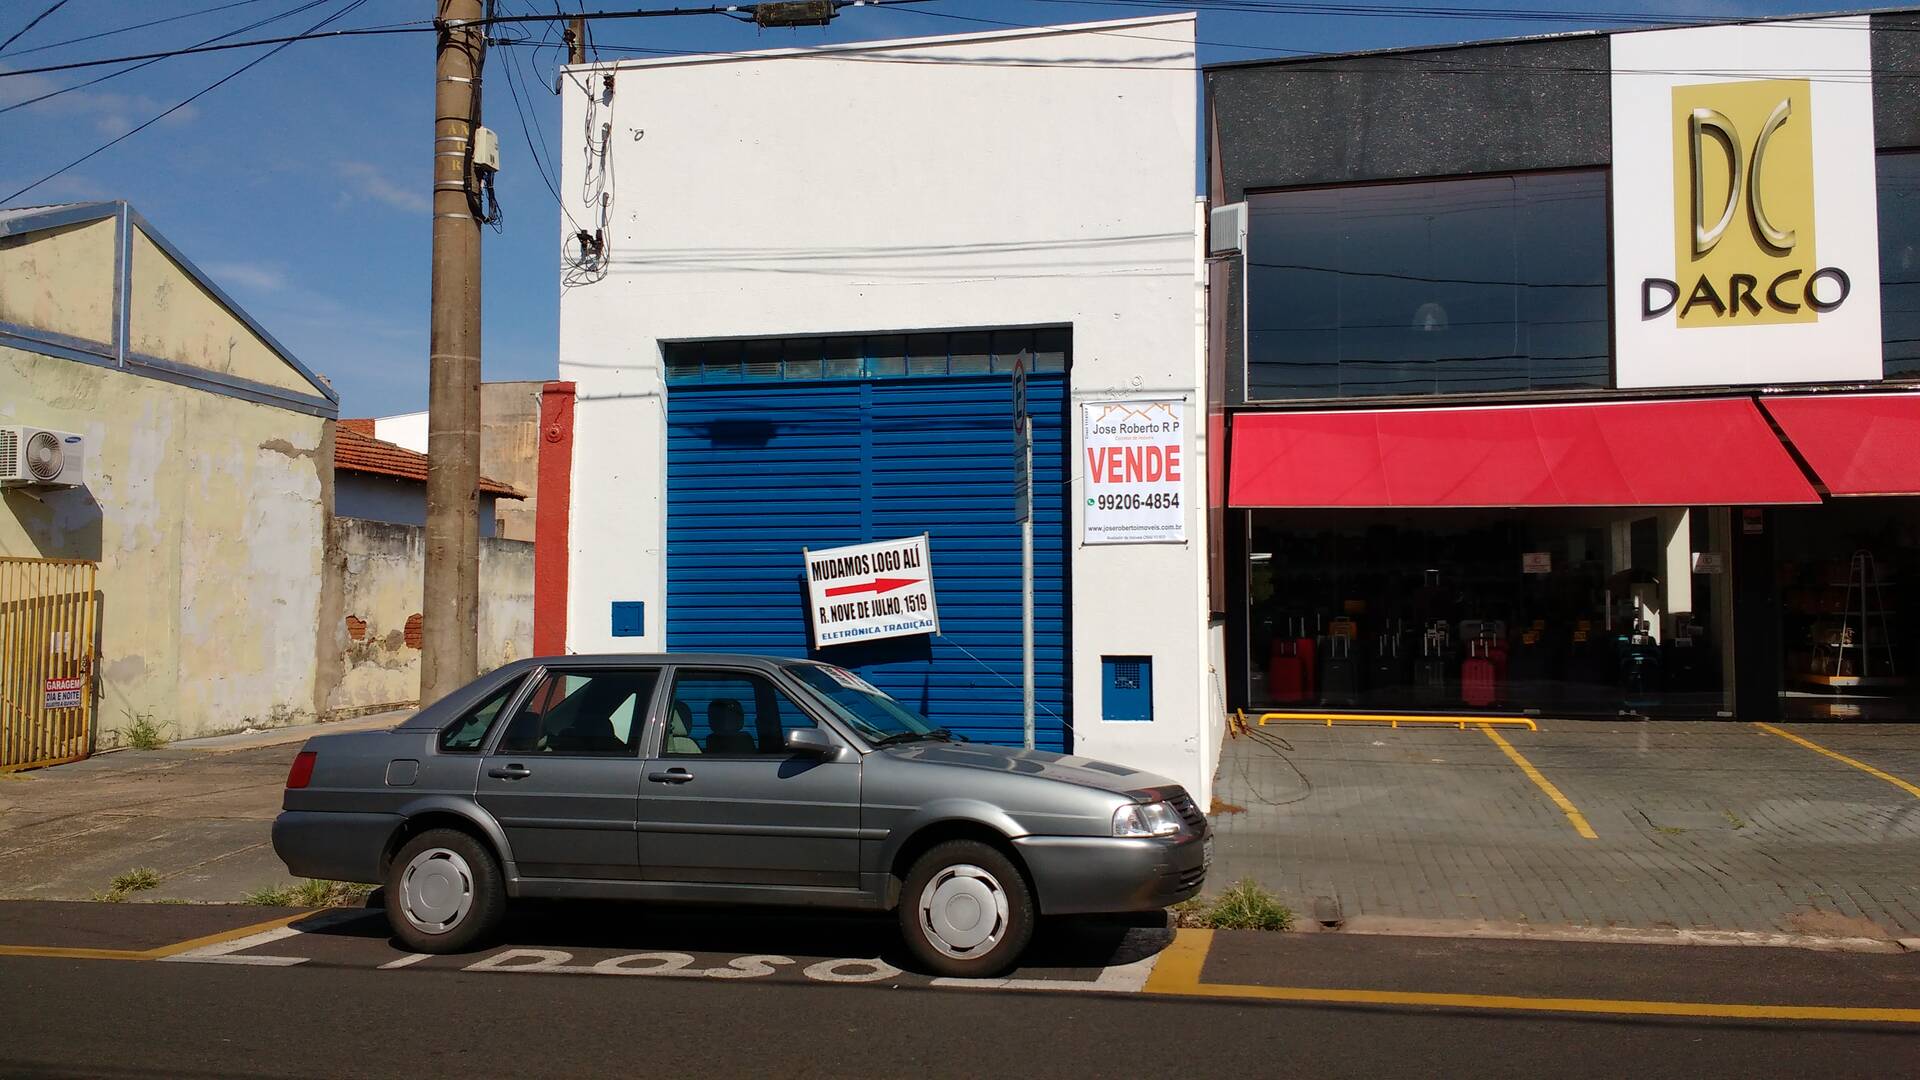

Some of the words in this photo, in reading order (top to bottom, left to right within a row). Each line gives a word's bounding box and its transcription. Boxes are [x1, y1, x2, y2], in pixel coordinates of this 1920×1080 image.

[1689, 97, 1796, 254] DC
[1642, 266, 1850, 321] DARCO
[1093, 424, 1117, 435] Jose
[1119, 423, 1160, 434] Roberto
[1162, 421, 1170, 432] R
[1173, 421, 1180, 432] P
[1087, 445, 1181, 483] VENDE
[1098, 493, 1180, 510] 99206-4854
[1088, 524, 1182, 533] www.joserobertoimoveis.com.br
[811, 554, 870, 581] MUDAMOS
[871, 550, 901, 573] LOGO
[903, 543, 921, 569] ALÍ
[819, 607, 830, 624] R.
[830, 602, 856, 623] NOVE
[856, 600, 870, 619] DE
[871, 596, 904, 617] JULHO,
[904, 593, 928, 613] 1519
[822, 626, 881, 640] ELETRÔNICA
[883, 619, 933, 632] TRADIÇÃO
[46, 680, 80, 690] GARAGEM
[46, 692, 57, 701] DIA
[57, 692, 62, 701] E
[62, 691, 80, 700] NOITE
